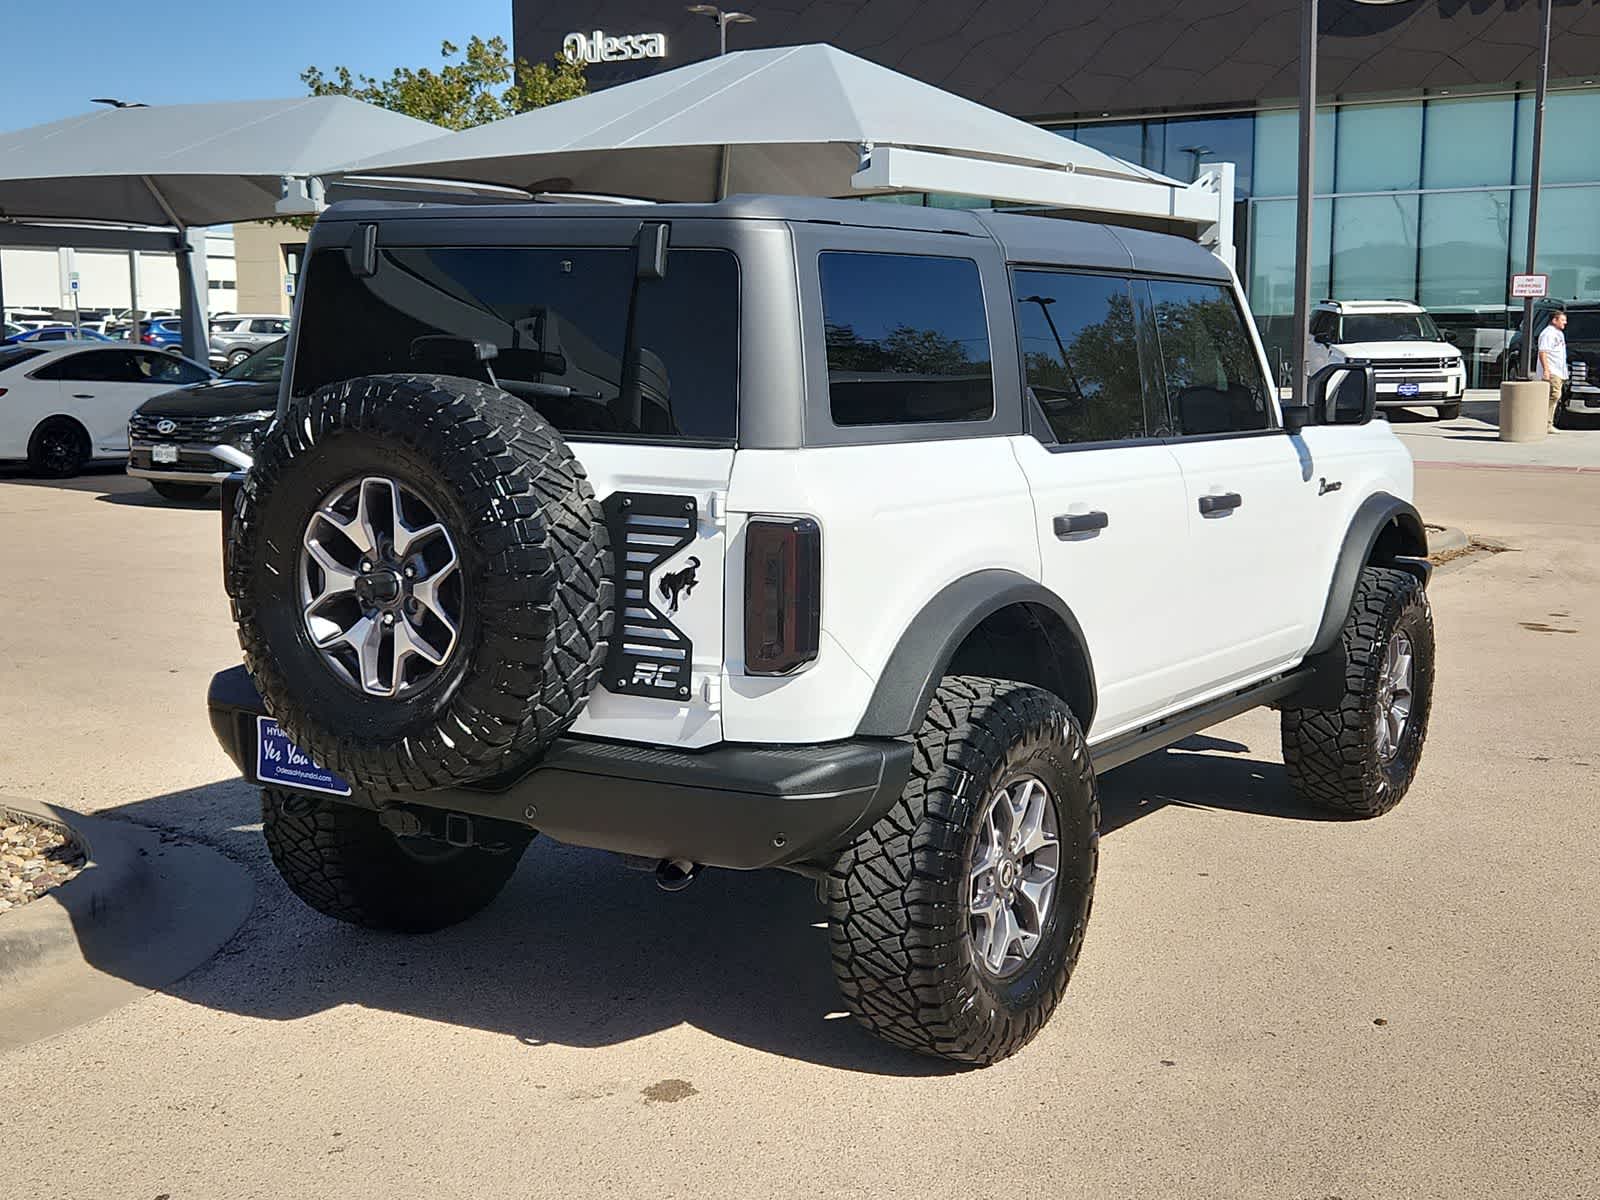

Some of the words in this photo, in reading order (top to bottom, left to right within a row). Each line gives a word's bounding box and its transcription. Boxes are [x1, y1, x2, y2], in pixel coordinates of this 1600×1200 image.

[563, 30, 665, 65] Odessa
[631, 662, 680, 688] RC
[264, 740, 282, 762] Yes
[287, 743, 308, 765] You
